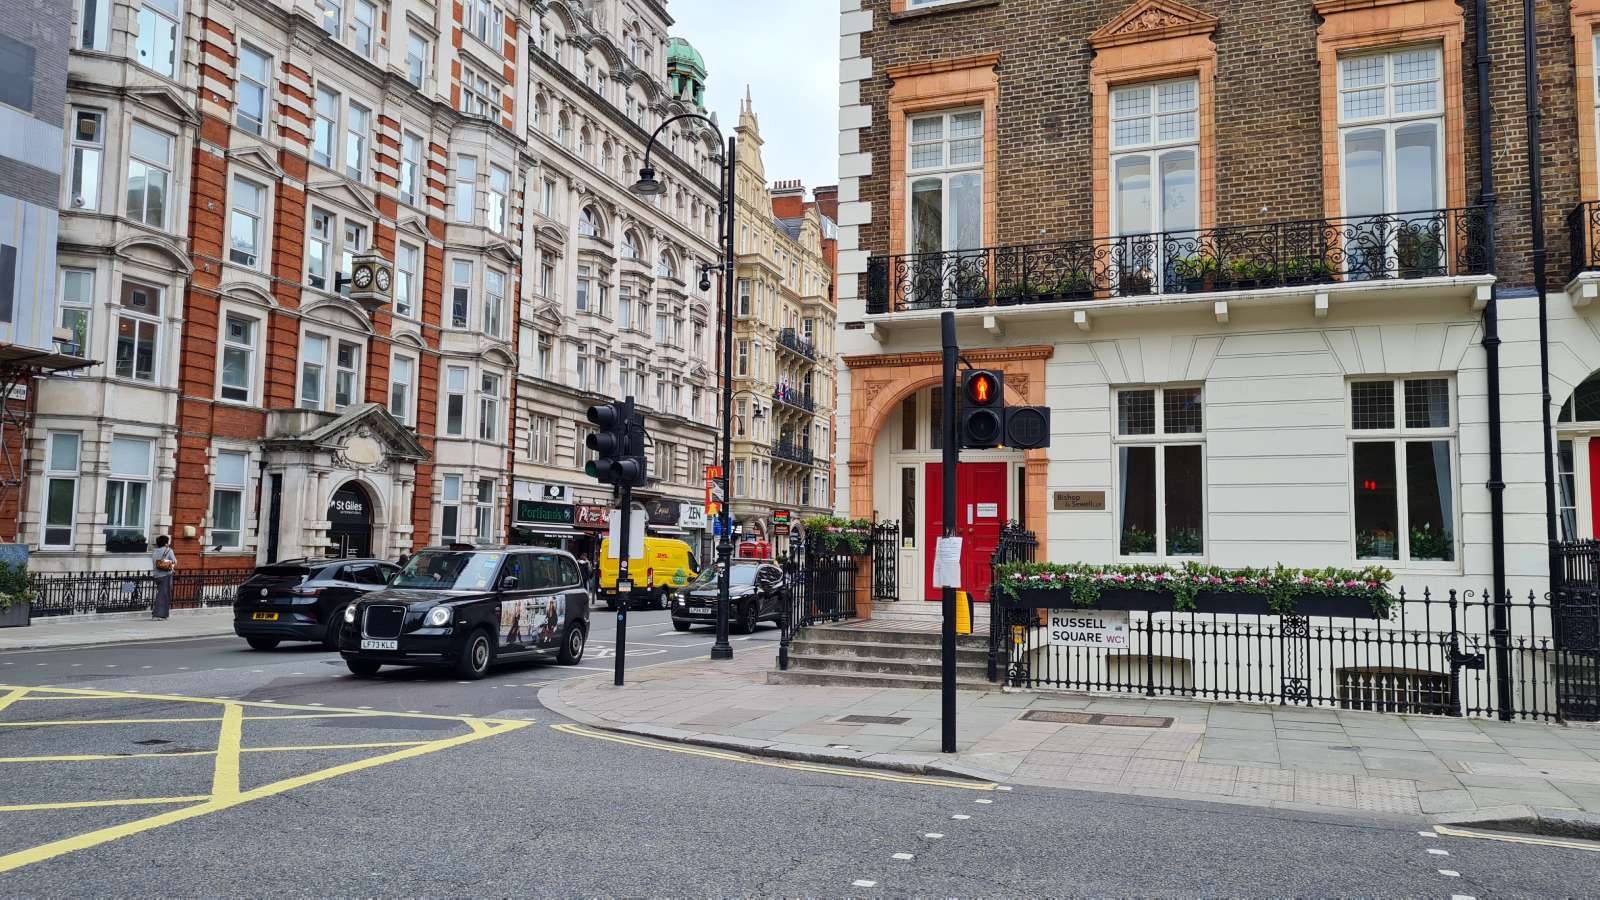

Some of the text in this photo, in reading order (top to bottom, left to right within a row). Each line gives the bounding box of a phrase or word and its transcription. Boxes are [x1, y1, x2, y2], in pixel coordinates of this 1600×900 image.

[1057, 494, 1080, 503] Bishop
[336, 500, 362, 511] St Giles
[688, 506, 701, 519] ZEN
[1052, 617, 1107, 629] RUSSELL
[1052, 630, 1125, 644] SQUARE WC1
[362, 640, 395, 649] LF73 KLC
